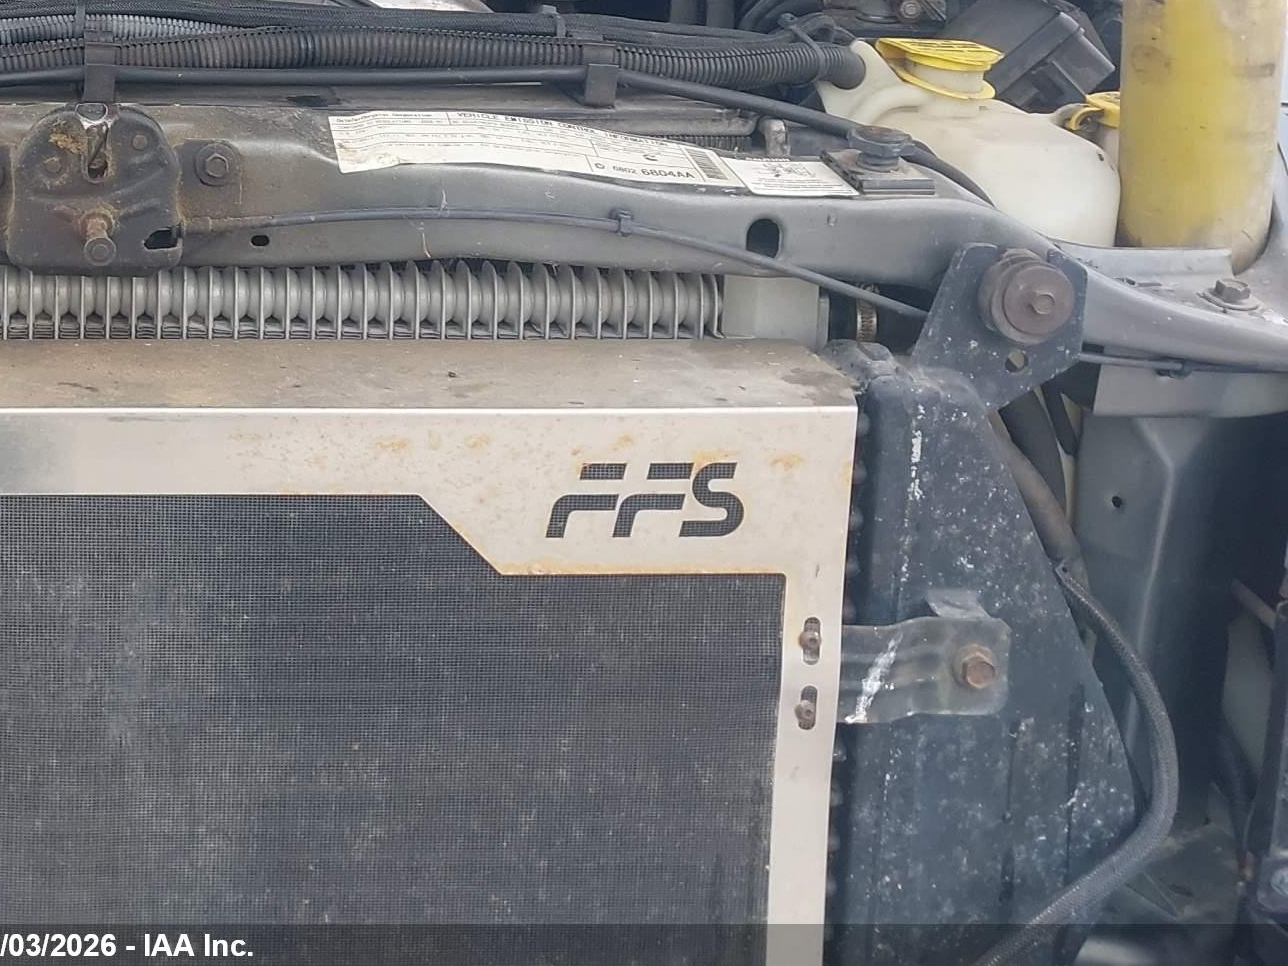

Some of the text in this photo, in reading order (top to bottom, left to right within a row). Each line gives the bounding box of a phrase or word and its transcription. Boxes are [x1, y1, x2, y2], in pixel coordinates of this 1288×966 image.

[456, 112, 496, 120] VEHICLE
[504, 115, 553, 127] EMISSION
[611, 165, 696, 179] 6802 6804AA
[545, 461, 745, 539] FFS
